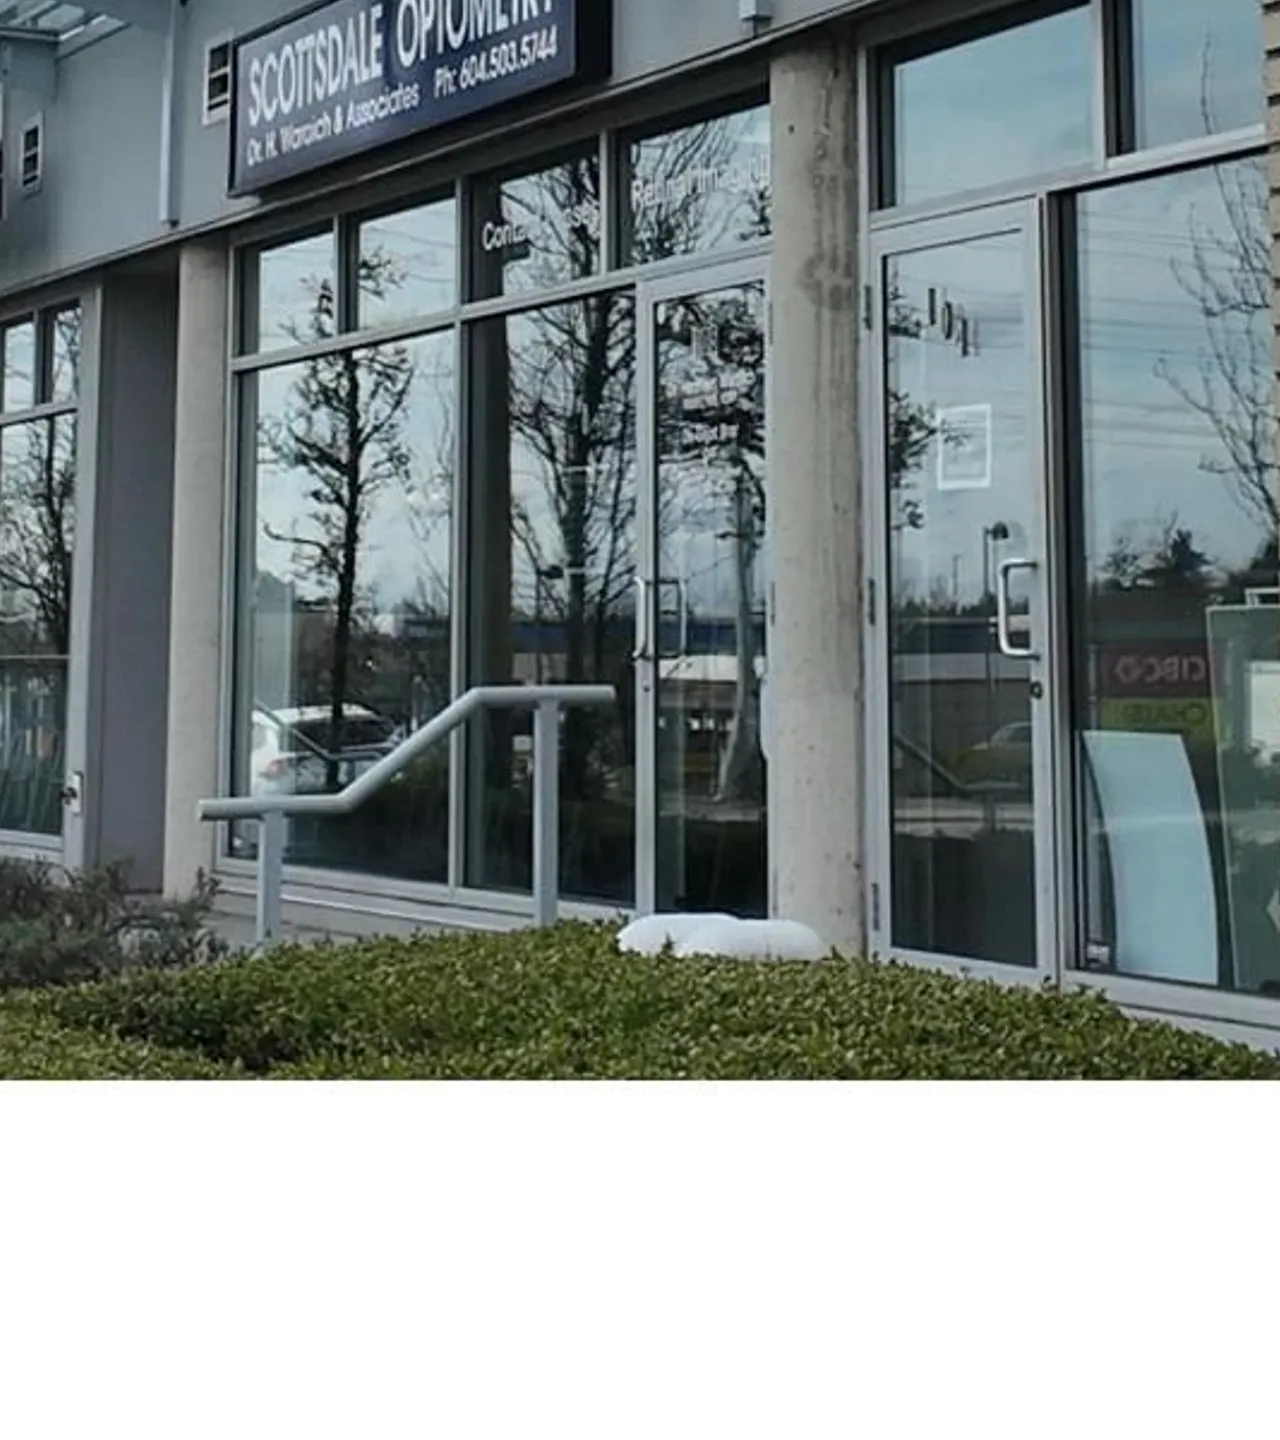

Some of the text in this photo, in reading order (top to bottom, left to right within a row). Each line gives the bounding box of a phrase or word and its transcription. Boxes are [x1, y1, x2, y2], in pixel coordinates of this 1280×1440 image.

[248, 1, 384, 128] SCOTTSDALE
[334, 104, 344, 135] &
[345, 81, 420, 130] Associates
[434, 64, 457, 99] Ph:
